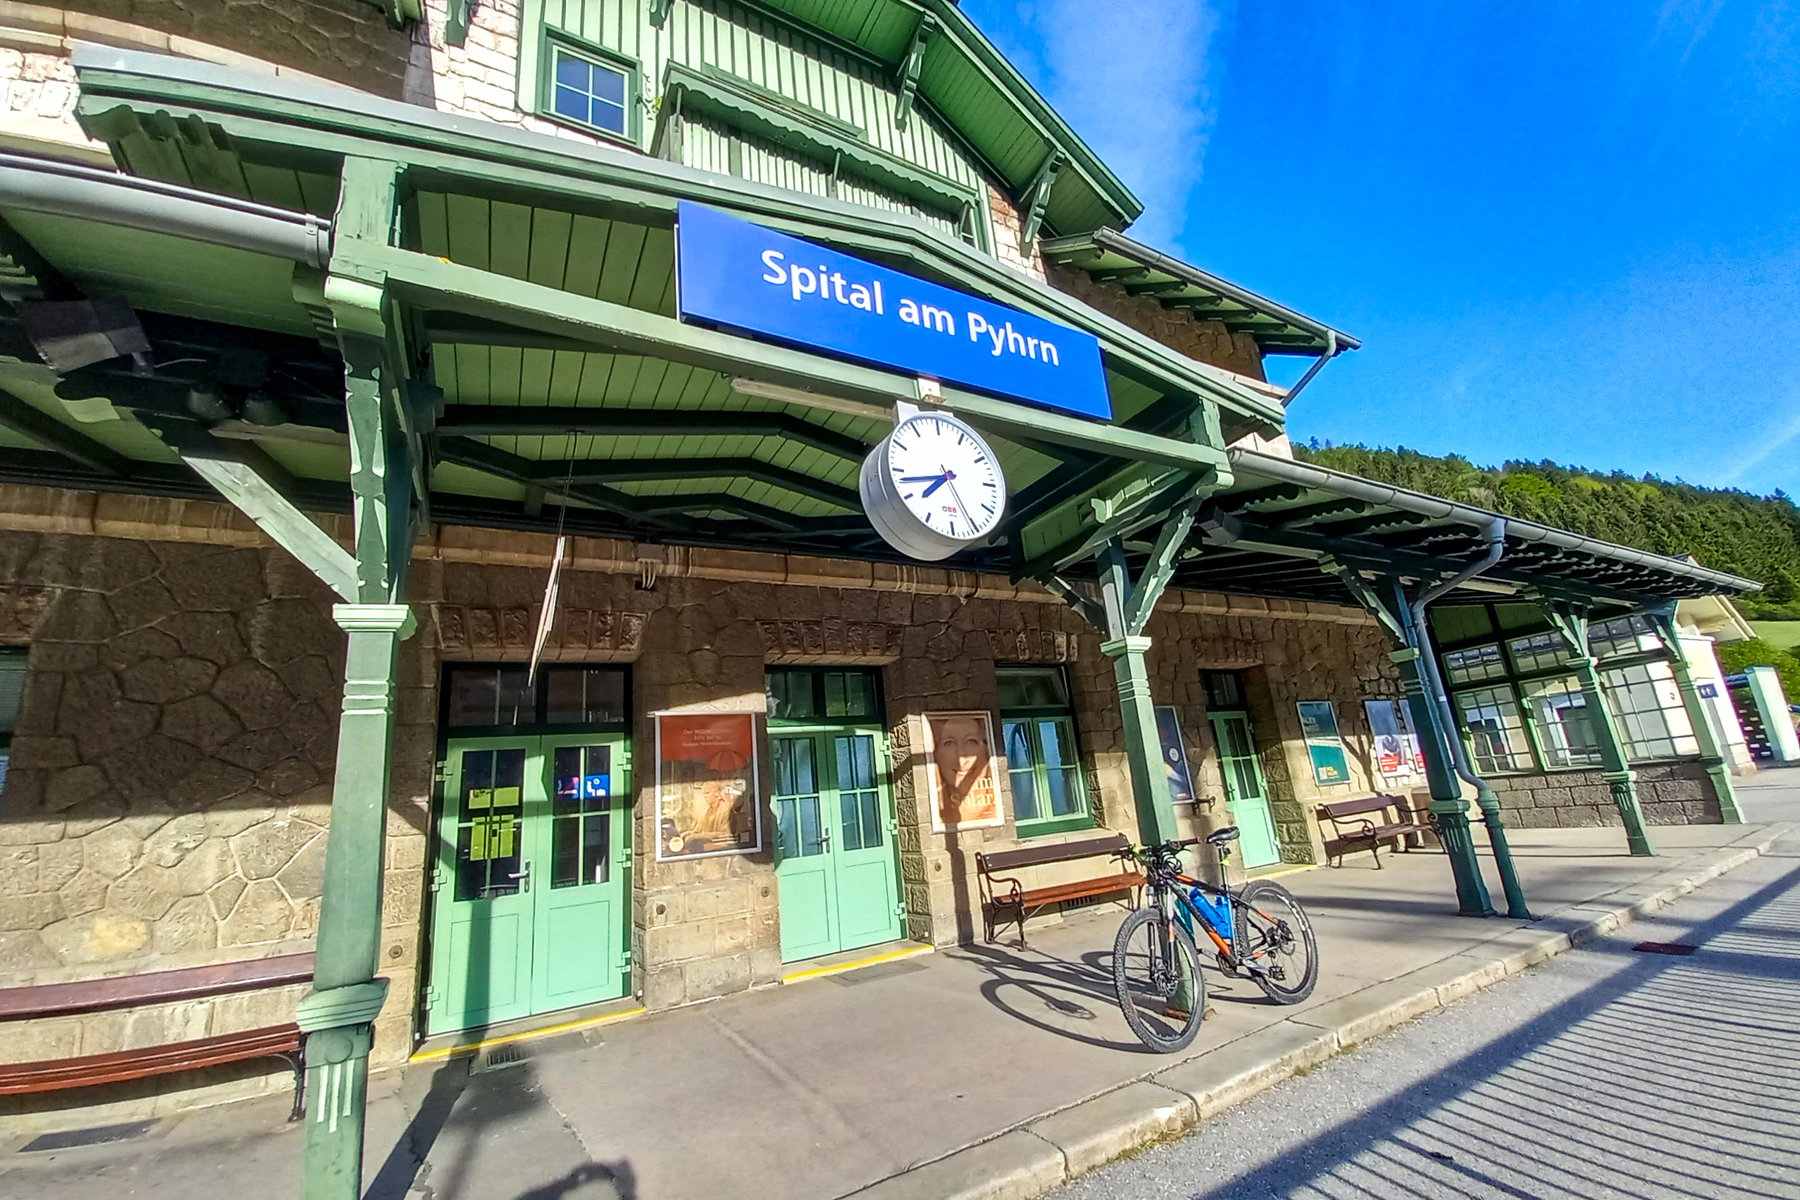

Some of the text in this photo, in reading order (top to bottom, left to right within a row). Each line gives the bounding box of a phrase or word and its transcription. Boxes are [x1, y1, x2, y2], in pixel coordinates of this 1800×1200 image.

[761, 249, 1060, 366] Spital am Pyhrn
